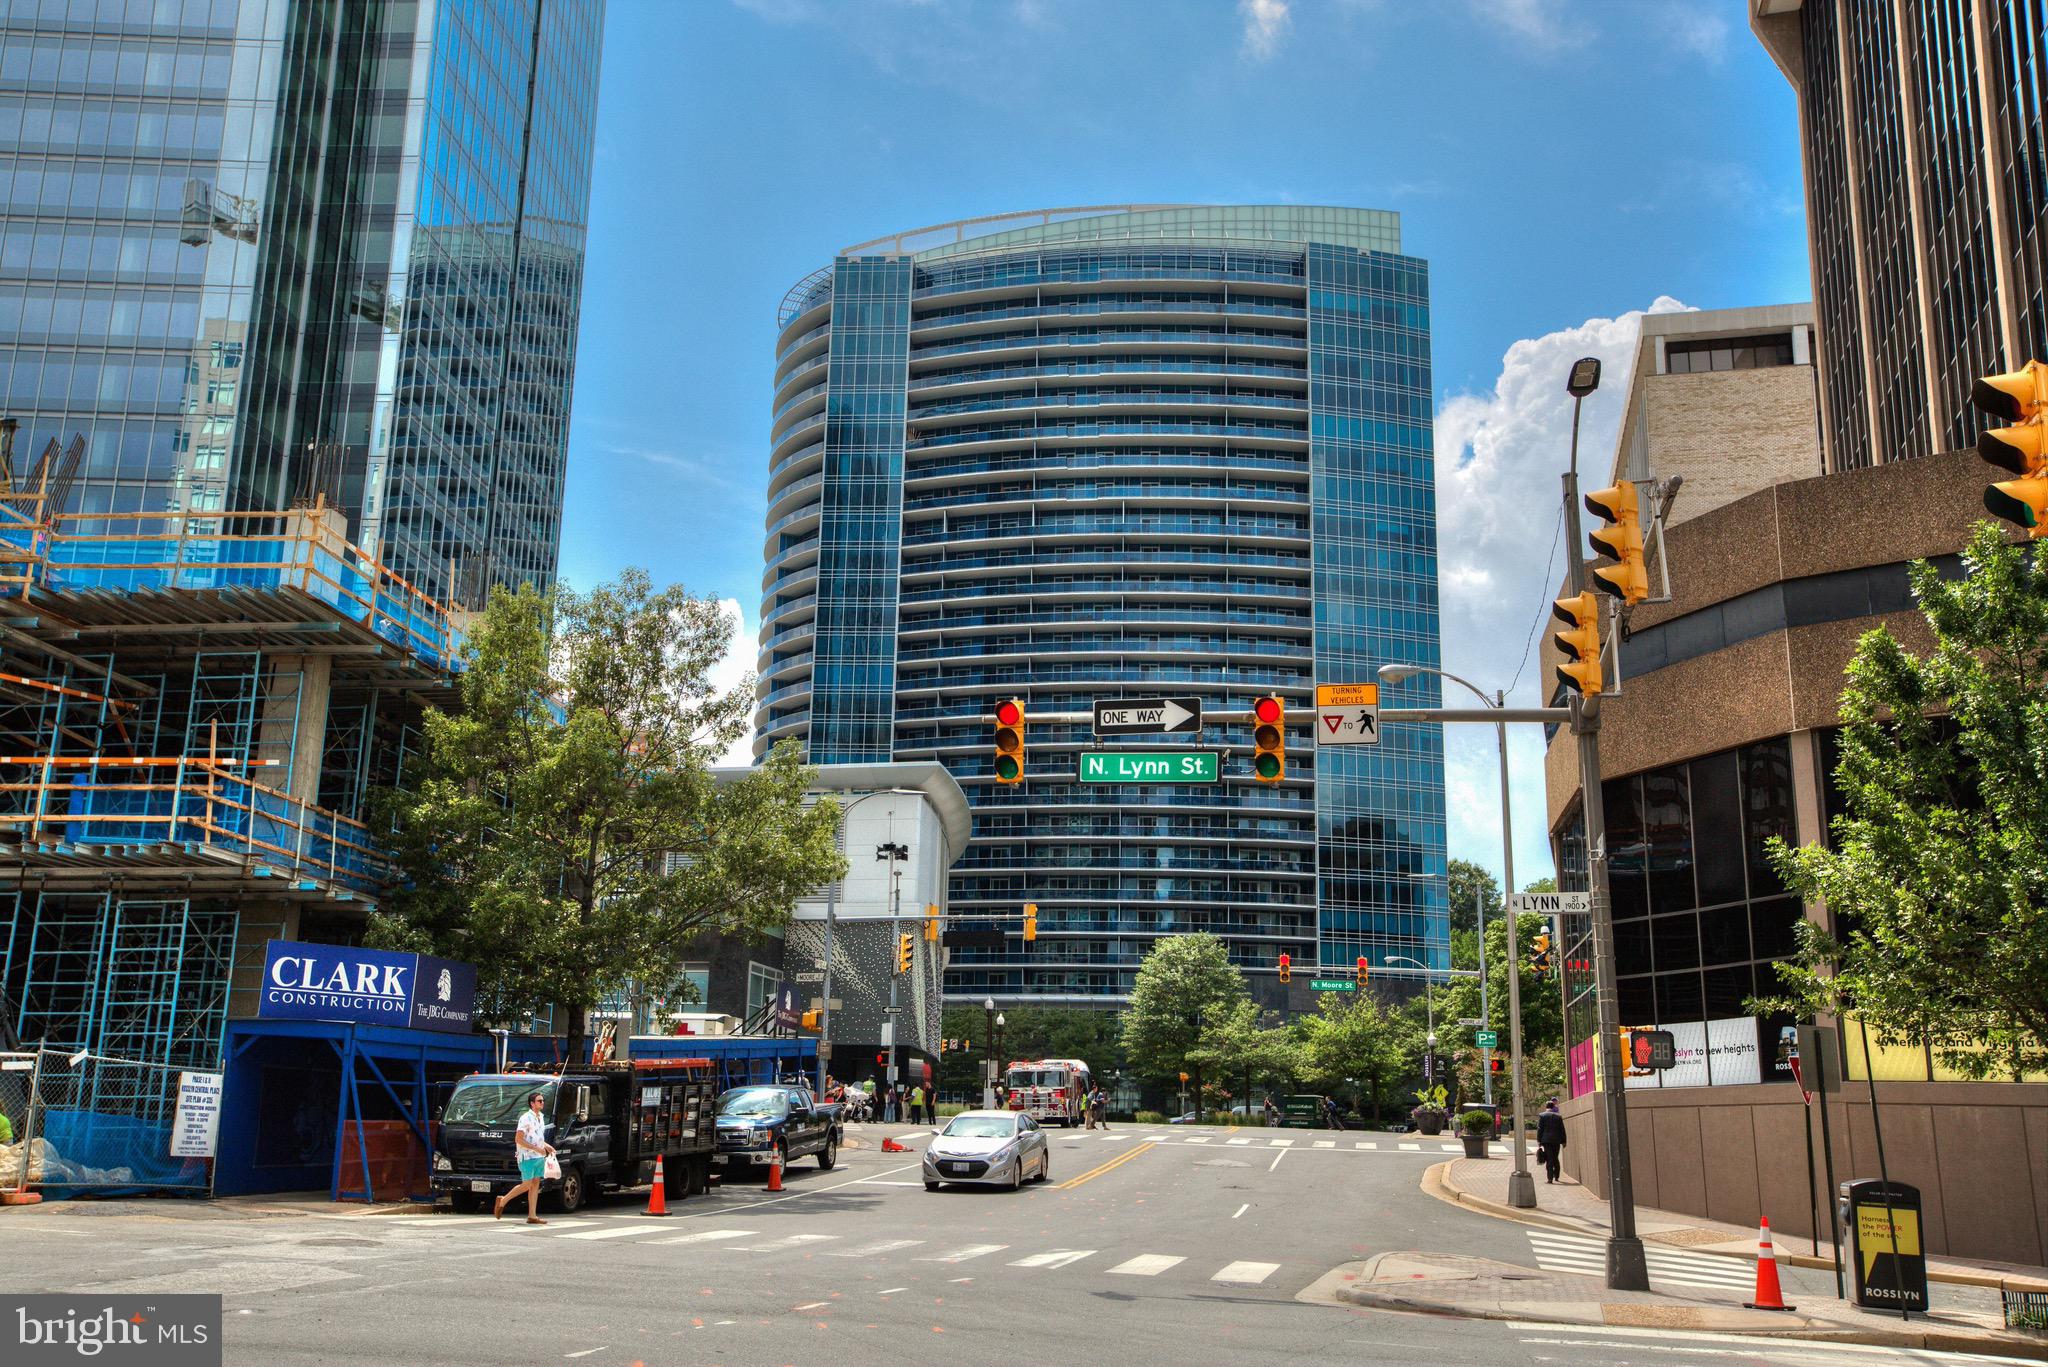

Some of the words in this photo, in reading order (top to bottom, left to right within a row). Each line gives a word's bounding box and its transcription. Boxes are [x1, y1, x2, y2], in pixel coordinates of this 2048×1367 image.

[1103, 711, 1128, 724] ONE
[1137, 710, 1164, 722] WAY
[1089, 757, 1109, 775] N.
[1119, 757, 1170, 778] Lynn
[1181, 757, 1209, 775] St.
[1522, 896, 1560, 910] LYNN
[272, 956, 407, 997] CLARK
[1321, 981, 1343, 989] Moore
[269, 991, 406, 1013] CONSTRUCTION
[1674, 1048, 1693, 1058] sslyn
[1723, 1043, 1755, 1056] heights
[1866, 1287, 1920, 1300] ROSSLYN
